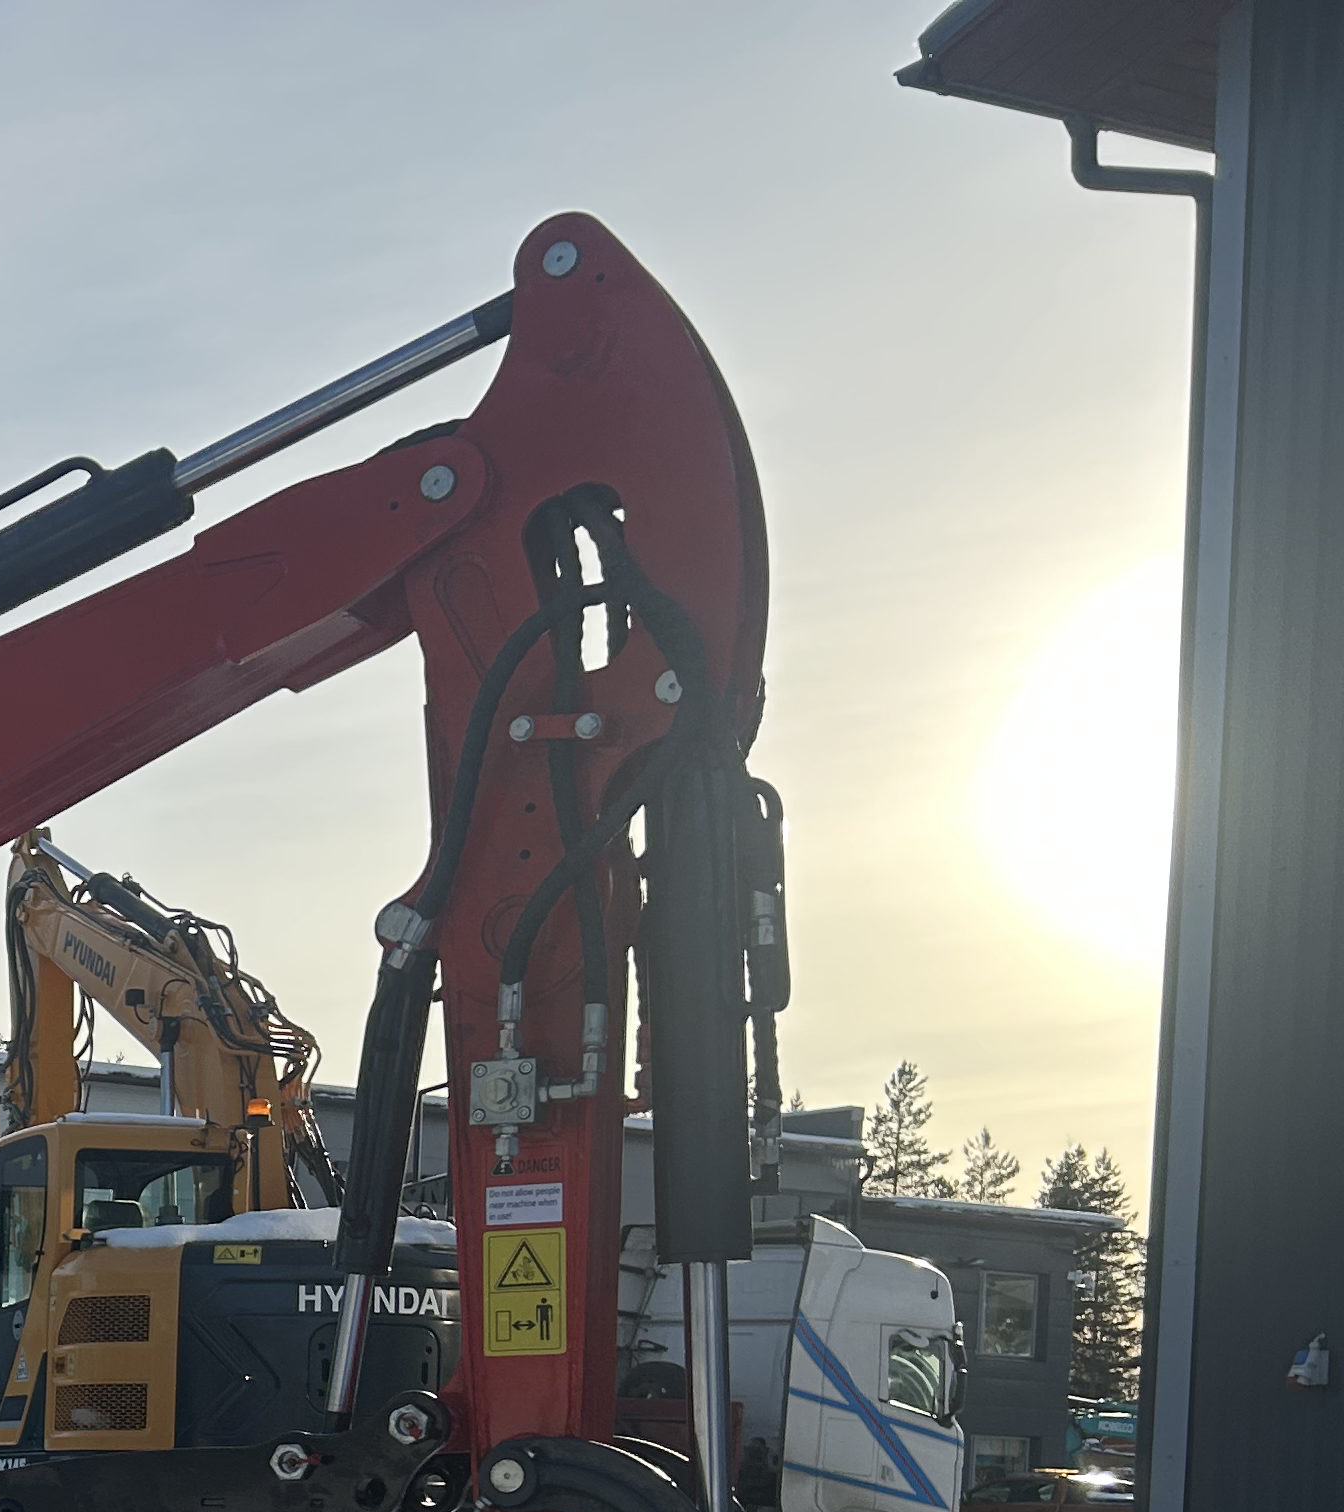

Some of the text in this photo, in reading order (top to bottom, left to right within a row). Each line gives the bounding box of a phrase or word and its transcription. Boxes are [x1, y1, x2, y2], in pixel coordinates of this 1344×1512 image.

[63, 931, 116, 987] HYUNDAI
[518, 1156, 561, 1174] DANGER
[489, 1190, 500, 1198] Do
[515, 1188, 533, 1196] allow
[535, 1186, 560, 1197] people
[506, 1200, 537, 1208] machine
[298, 1285, 448, 1318] HYNDAI
